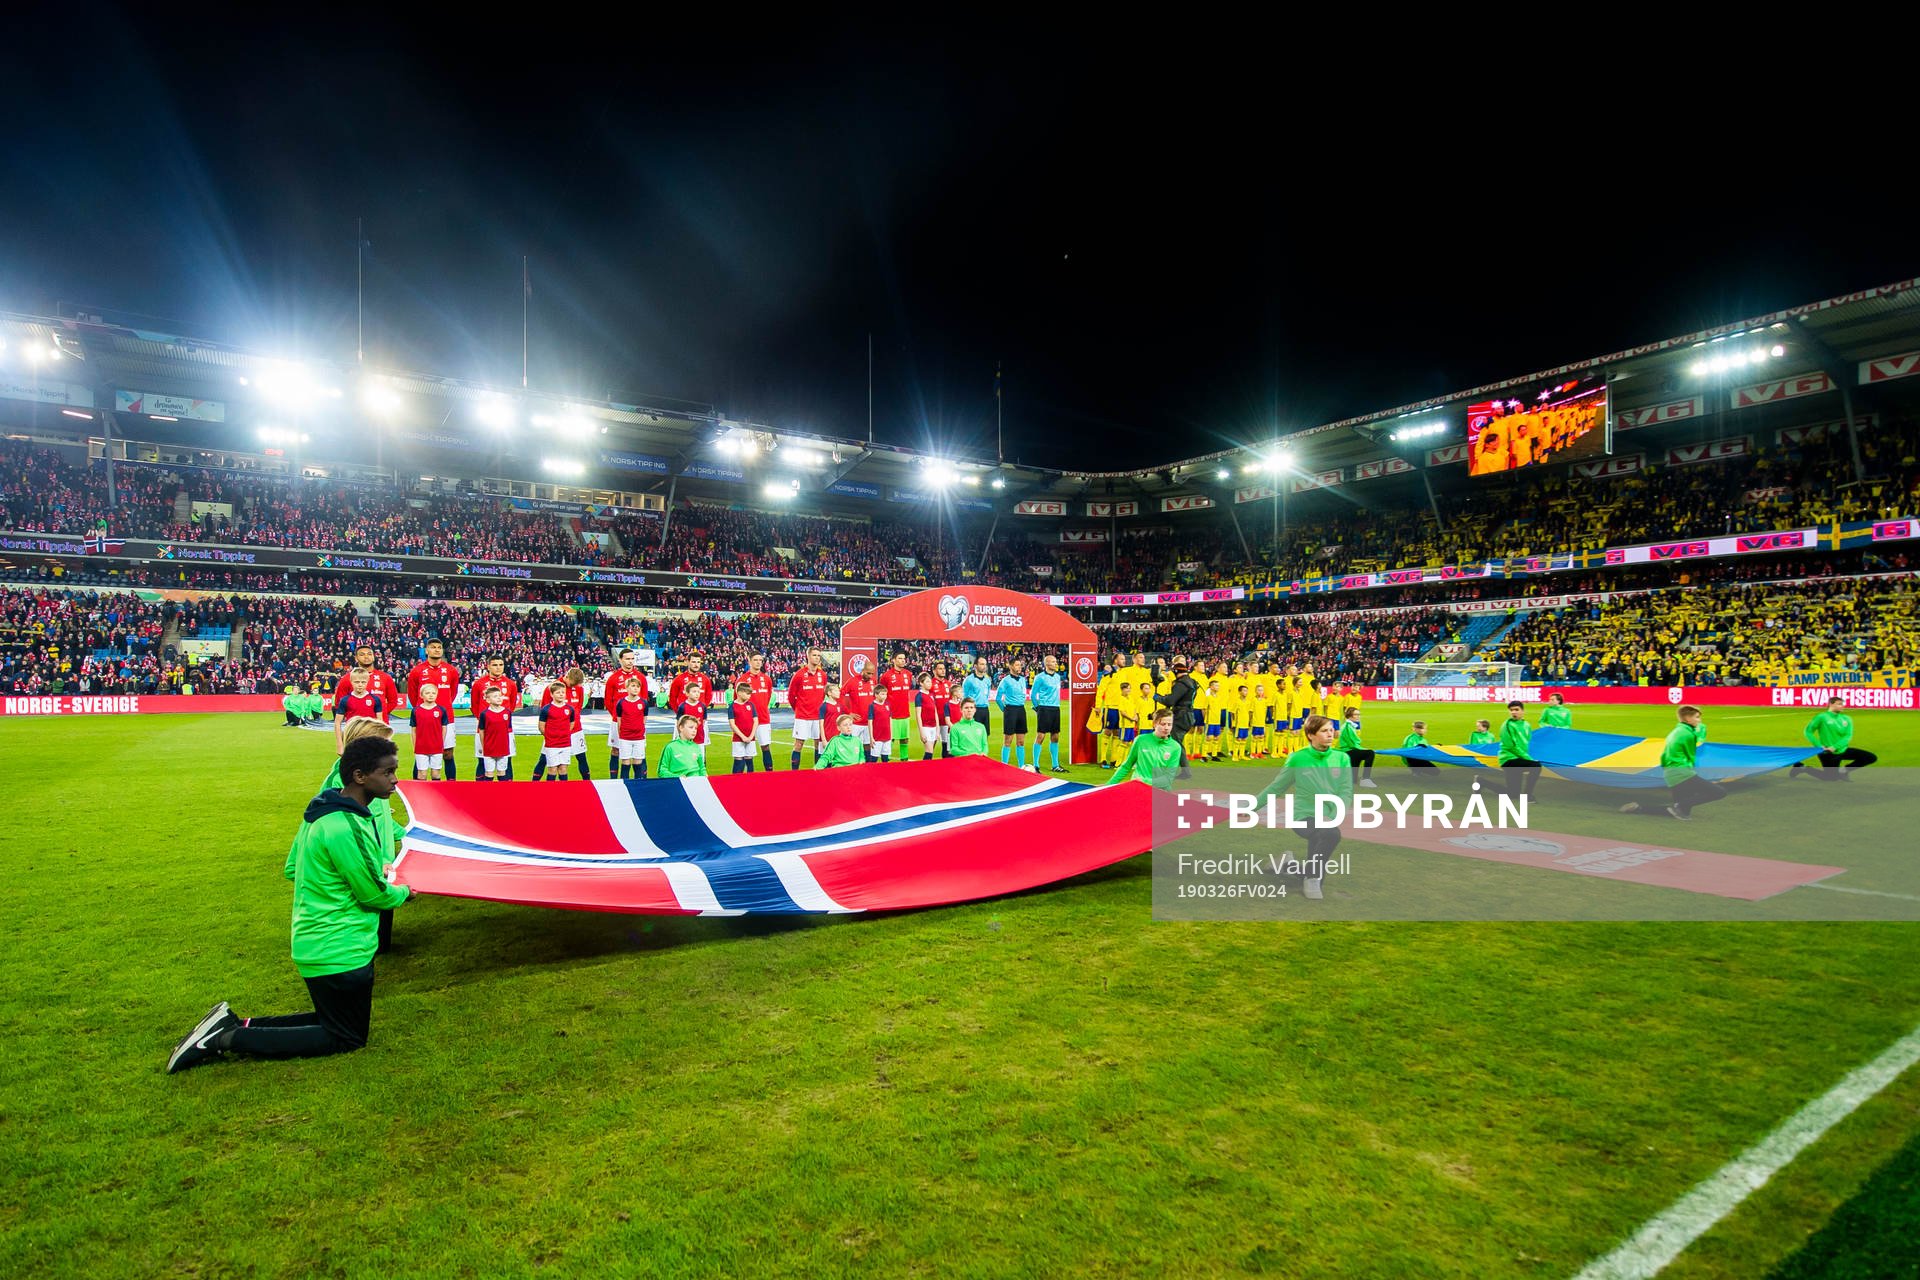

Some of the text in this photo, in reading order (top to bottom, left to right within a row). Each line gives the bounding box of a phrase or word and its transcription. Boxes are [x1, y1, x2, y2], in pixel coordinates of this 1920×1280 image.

[1454, 390, 1472, 398] VG
[1479, 383, 1500, 392] VG
[1508, 377, 1528, 385] VG
[1537, 369, 1559, 378] VG
[1568, 361, 1591, 370] VG
[1600, 352, 1623, 362] VG
[1634, 342, 1660, 353] VG
[1668, 334, 1696, 345] VG
[1747, 313, 1774, 325] VG
[1788, 303, 1820, 315] VG
[1832, 292, 1864, 305] VG
[1878, 280, 1912, 293] VG
[1873, 355, 1919, 377] V
[1743, 376, 1825, 402] VG
[1622, 401, 1690, 426] VG
[1672, 438, 1745, 461] VG
[611, 457, 637, 467] NORSK
[1579, 459, 1636, 477] VG
[692, 467, 743, 479] NORSK TIPPING
[1022, 502, 1060, 513] VG
[1172, 496, 1209, 508] VG
[1096, 503, 1131, 515] VG
[1067, 531, 1105, 540] VG
[1656, 523, 1906, 557] VG VG G
[178, 549, 212, 560] Norsk
[213, 550, 255, 563] Tipping
[334, 557, 365, 568] Norsk
[365, 558, 402, 571] Tipping
[472, 565, 499, 575] Norsk
[499, 566, 531, 578] Tipping
[593, 573, 616, 581] Norsk
[616, 573, 645, 583] Tipping
[700, 579, 720, 587] Norsk
[720, 579, 746, 590] Tipping
[794, 584, 813, 592] Norsk
[813, 584, 836, 594] Tipping
[1065, 596, 1095, 604] VG
[1112, 595, 1143, 604] VG
[1158, 593, 1188, 602] VG
[1204, 591, 1231, 600] VG
[1389, 571, 1421, 581] VG
[1492, 601, 1521, 609] VG
[1530, 598, 1559, 607] VG
[974, 605, 1018, 616] EUROPEAN
[969, 615, 1023, 627] QUALIFIERS
[1788, 672, 1872, 685] CAMP SWEDEN
